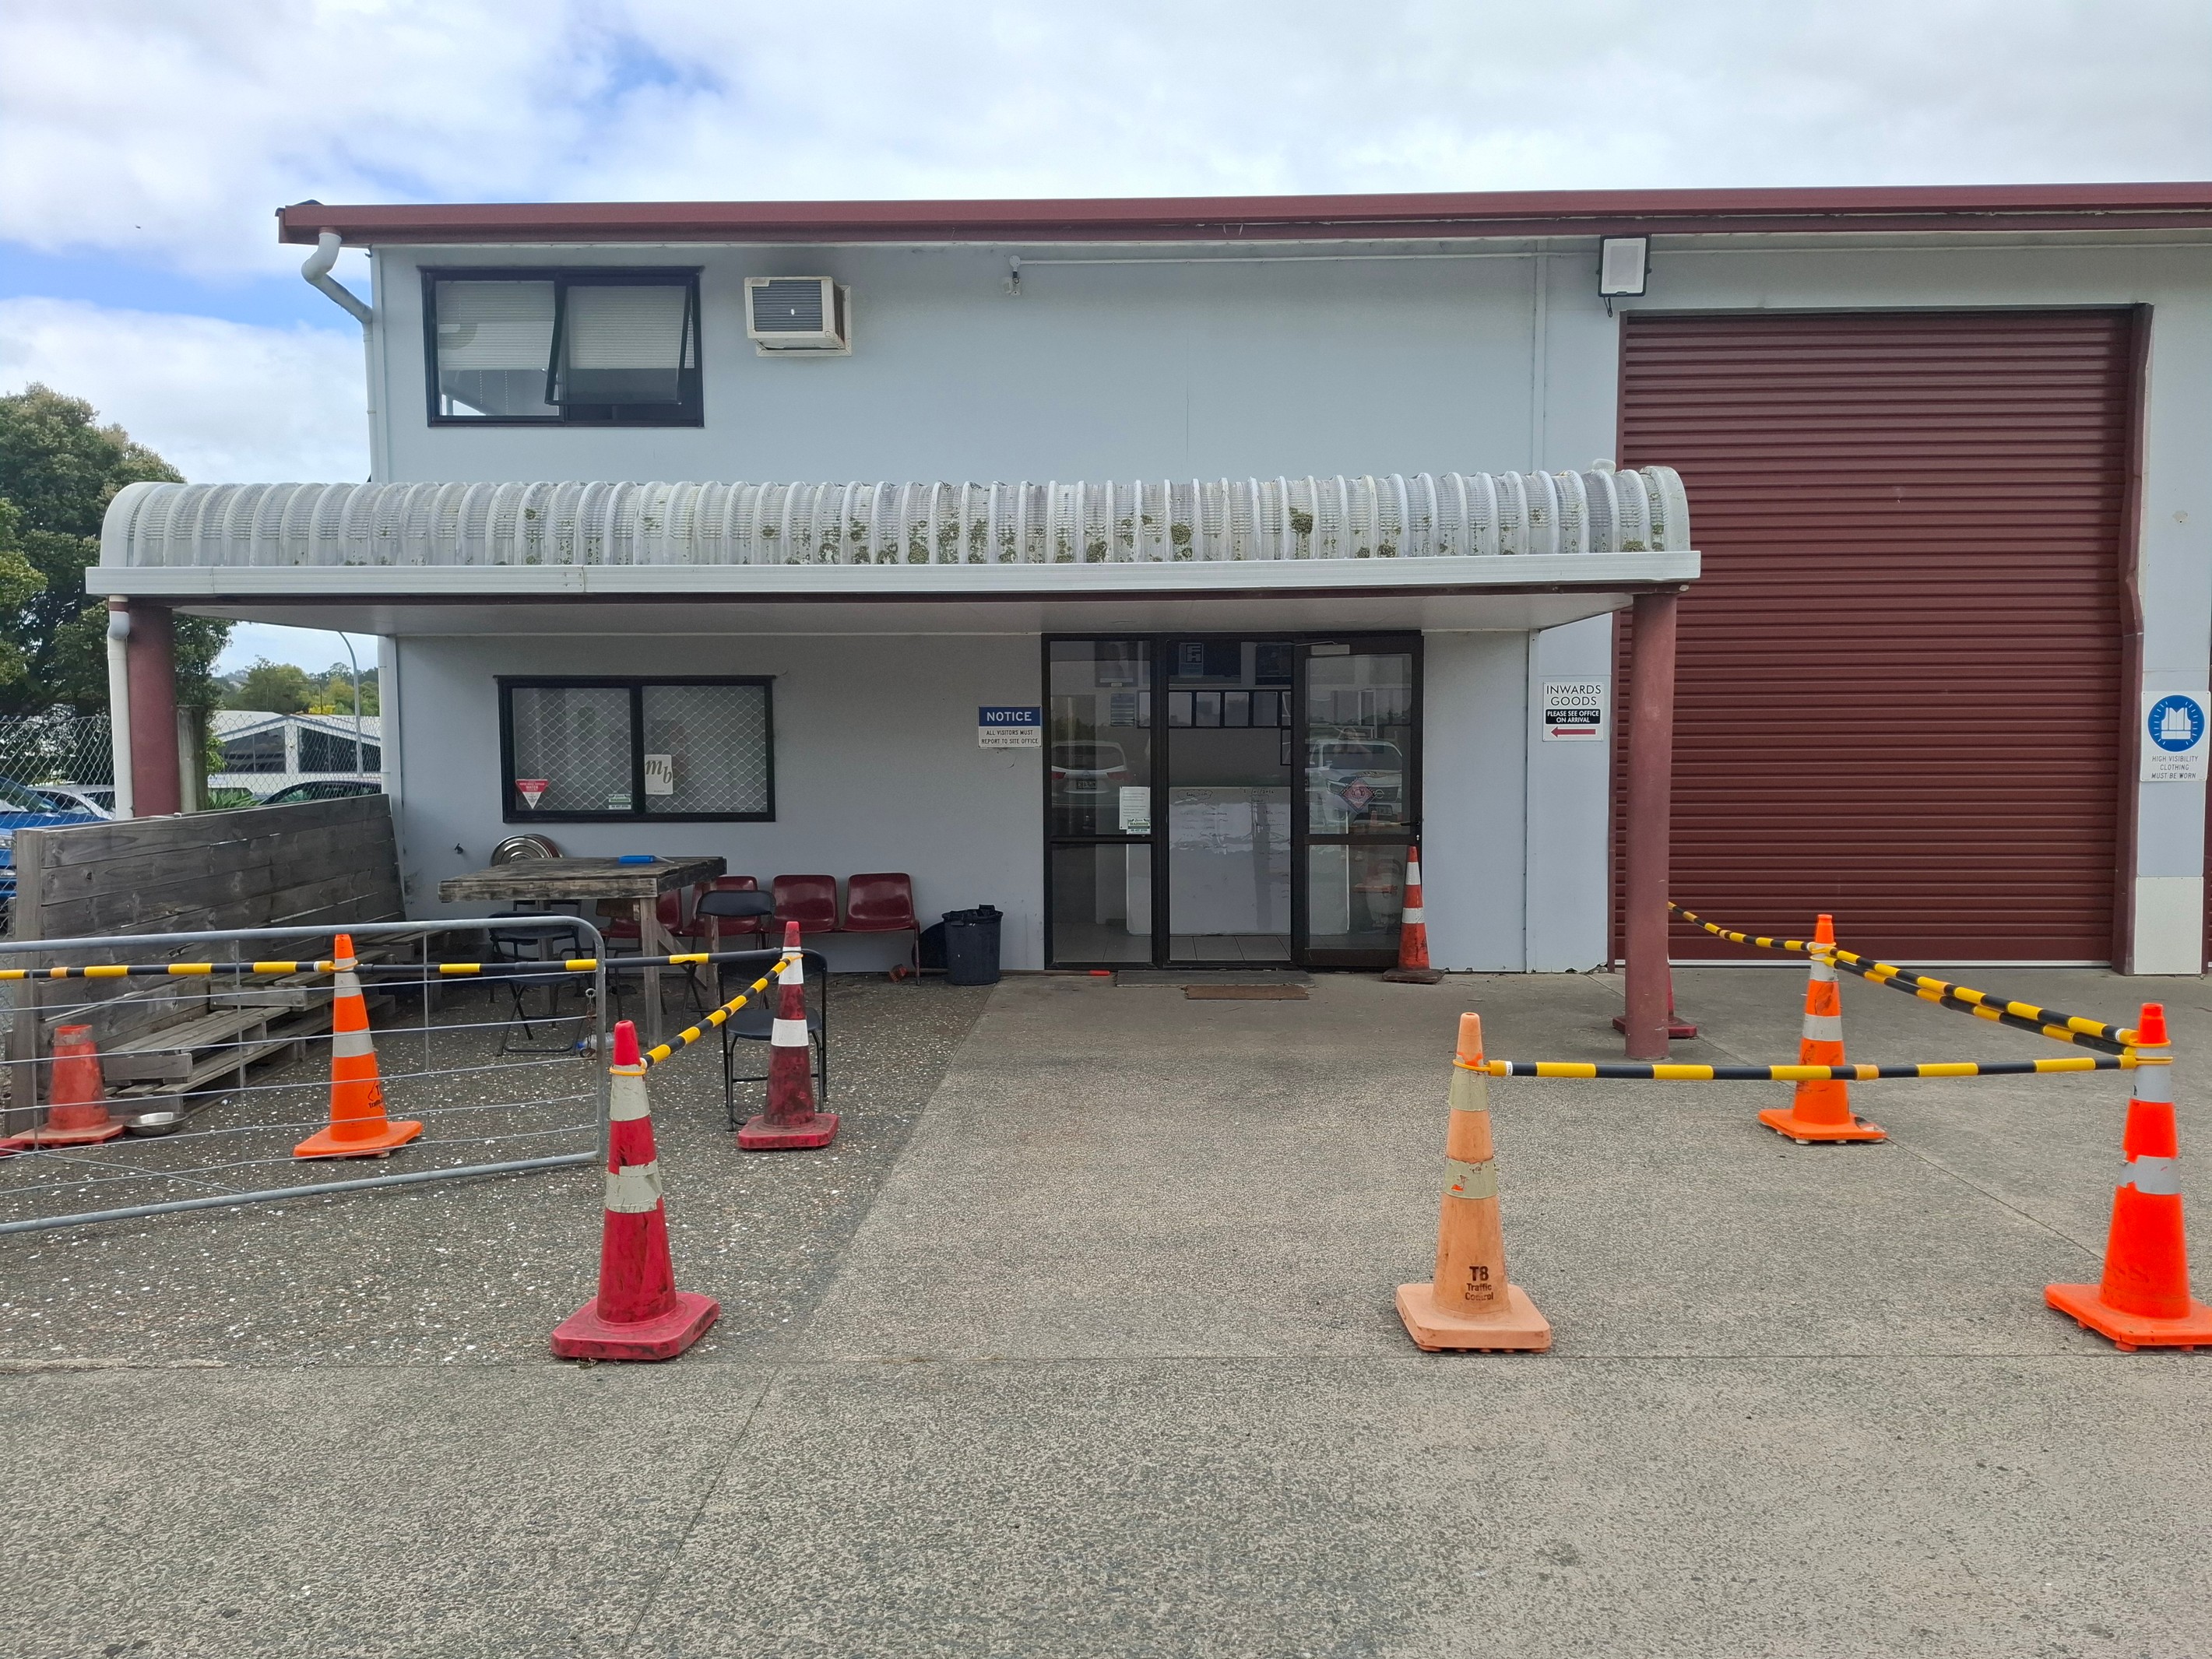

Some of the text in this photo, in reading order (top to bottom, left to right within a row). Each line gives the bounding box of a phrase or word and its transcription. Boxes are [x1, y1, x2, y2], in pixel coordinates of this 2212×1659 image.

[1546, 684, 1602, 694] INWARDS
[1550, 696, 1597, 706] GOODS
[986, 712, 1032, 722] NOTICE
[1466, 1282, 1492, 1292] Traffic
